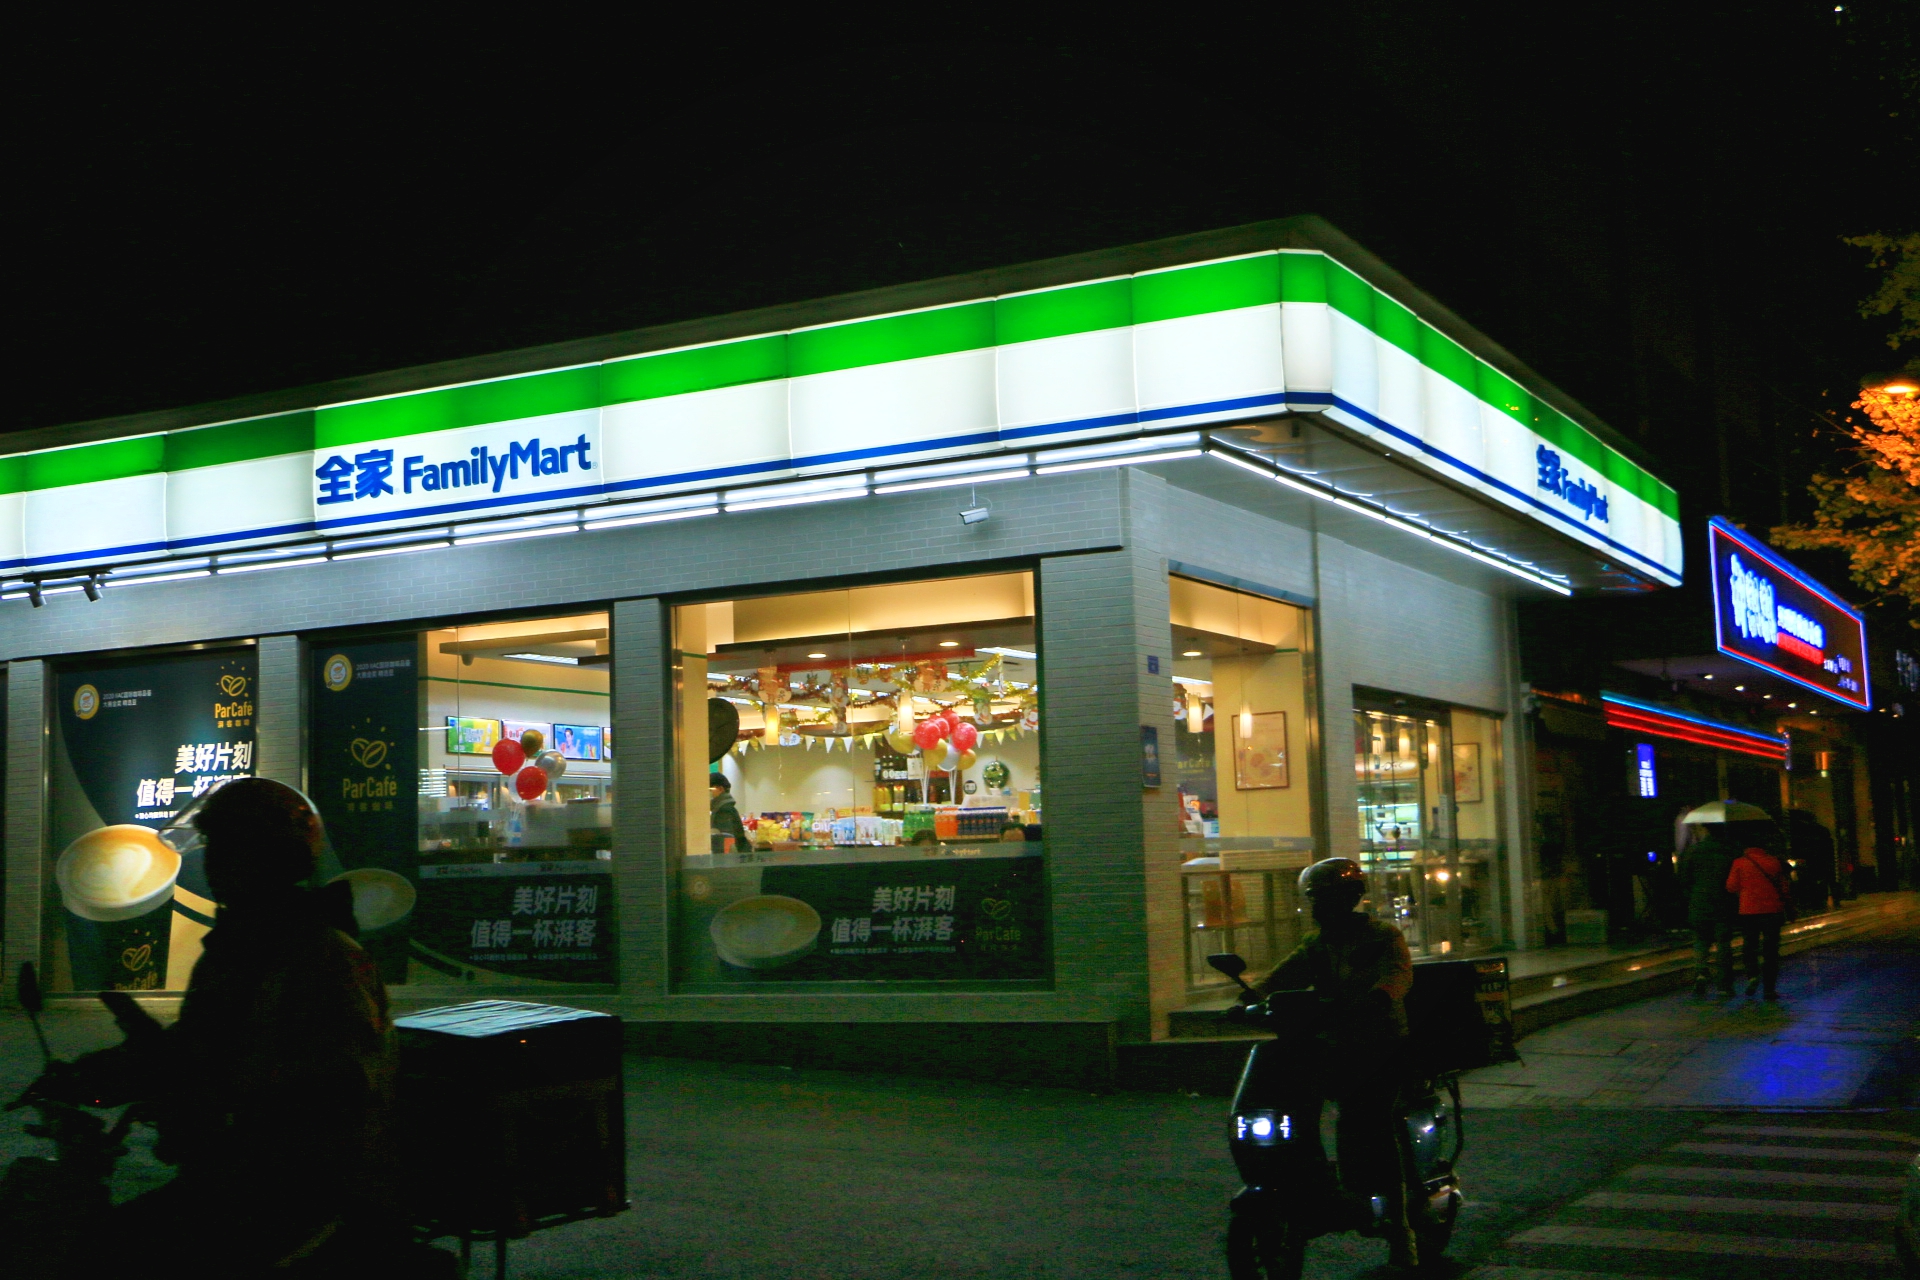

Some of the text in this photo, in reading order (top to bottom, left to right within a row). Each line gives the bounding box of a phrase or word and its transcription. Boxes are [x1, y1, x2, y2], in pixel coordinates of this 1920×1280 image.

[315, 433, 592, 506] 全家 FamilyMart
[174, 740, 253, 775] 美好片刻
[136, 772, 252, 808] 值得一杯
[512, 884, 598, 916] 美好片刻
[871, 884, 956, 914] 美好片刻
